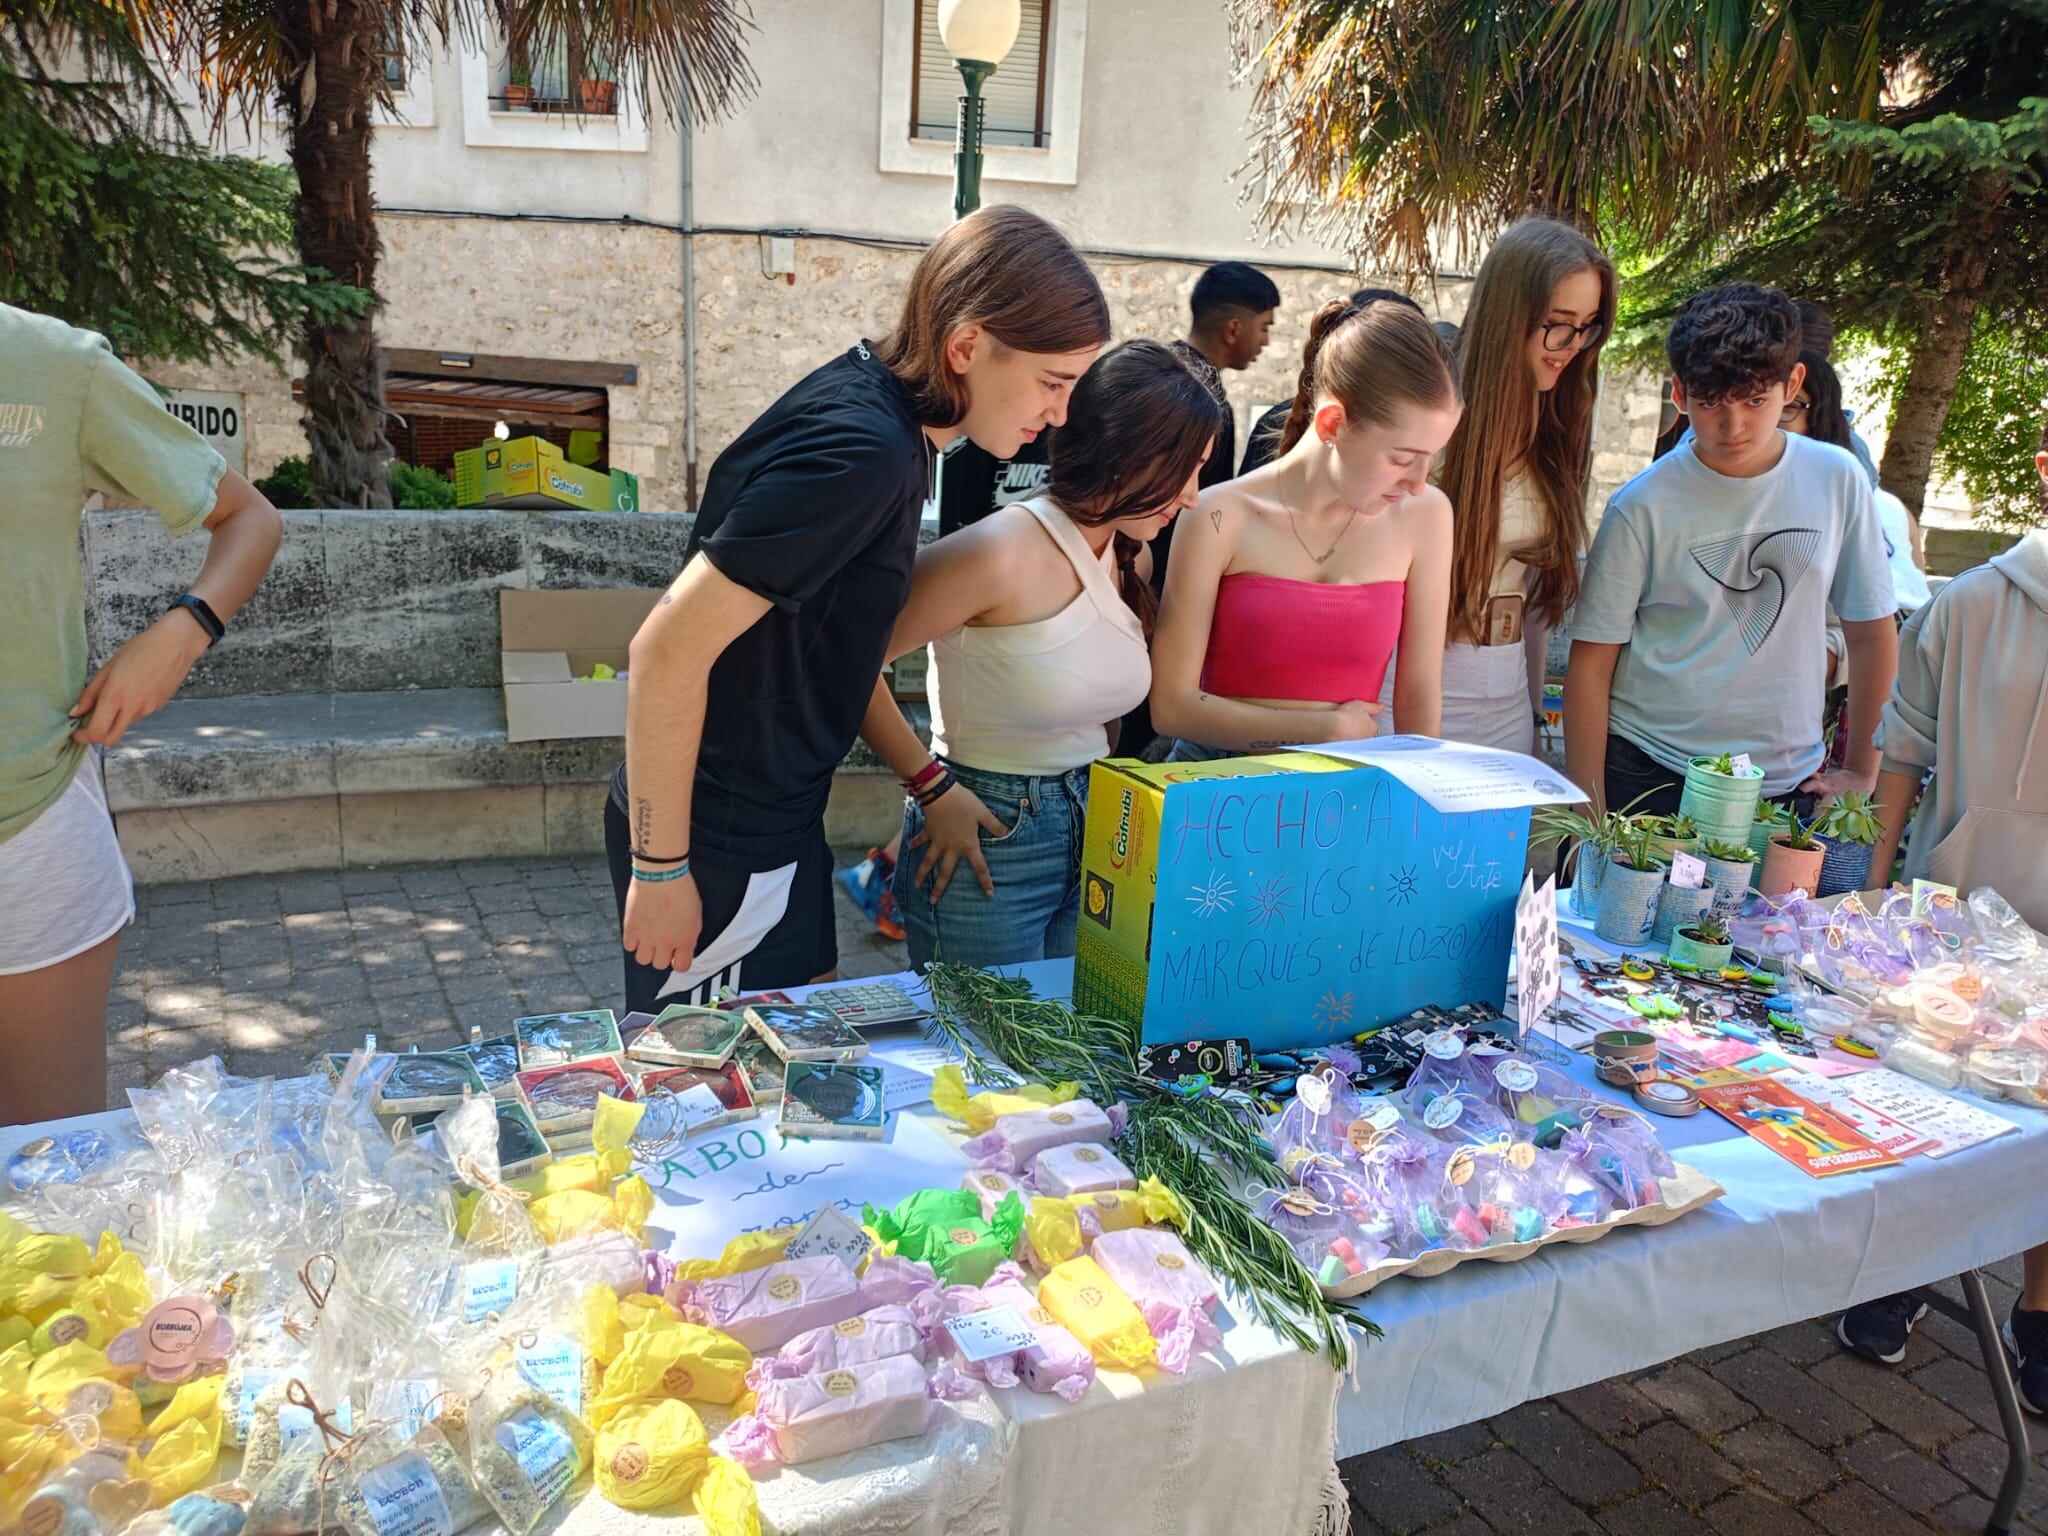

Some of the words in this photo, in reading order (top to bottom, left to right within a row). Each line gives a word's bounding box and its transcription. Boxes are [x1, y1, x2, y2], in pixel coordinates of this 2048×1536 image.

[1003, 463, 1052, 488] NIKE
[1115, 785, 1134, 858] Cofrubi
[1173, 788, 1345, 865] HECHO
[1366, 778, 1393, 843] A
[1302, 865, 1358, 922] IES
